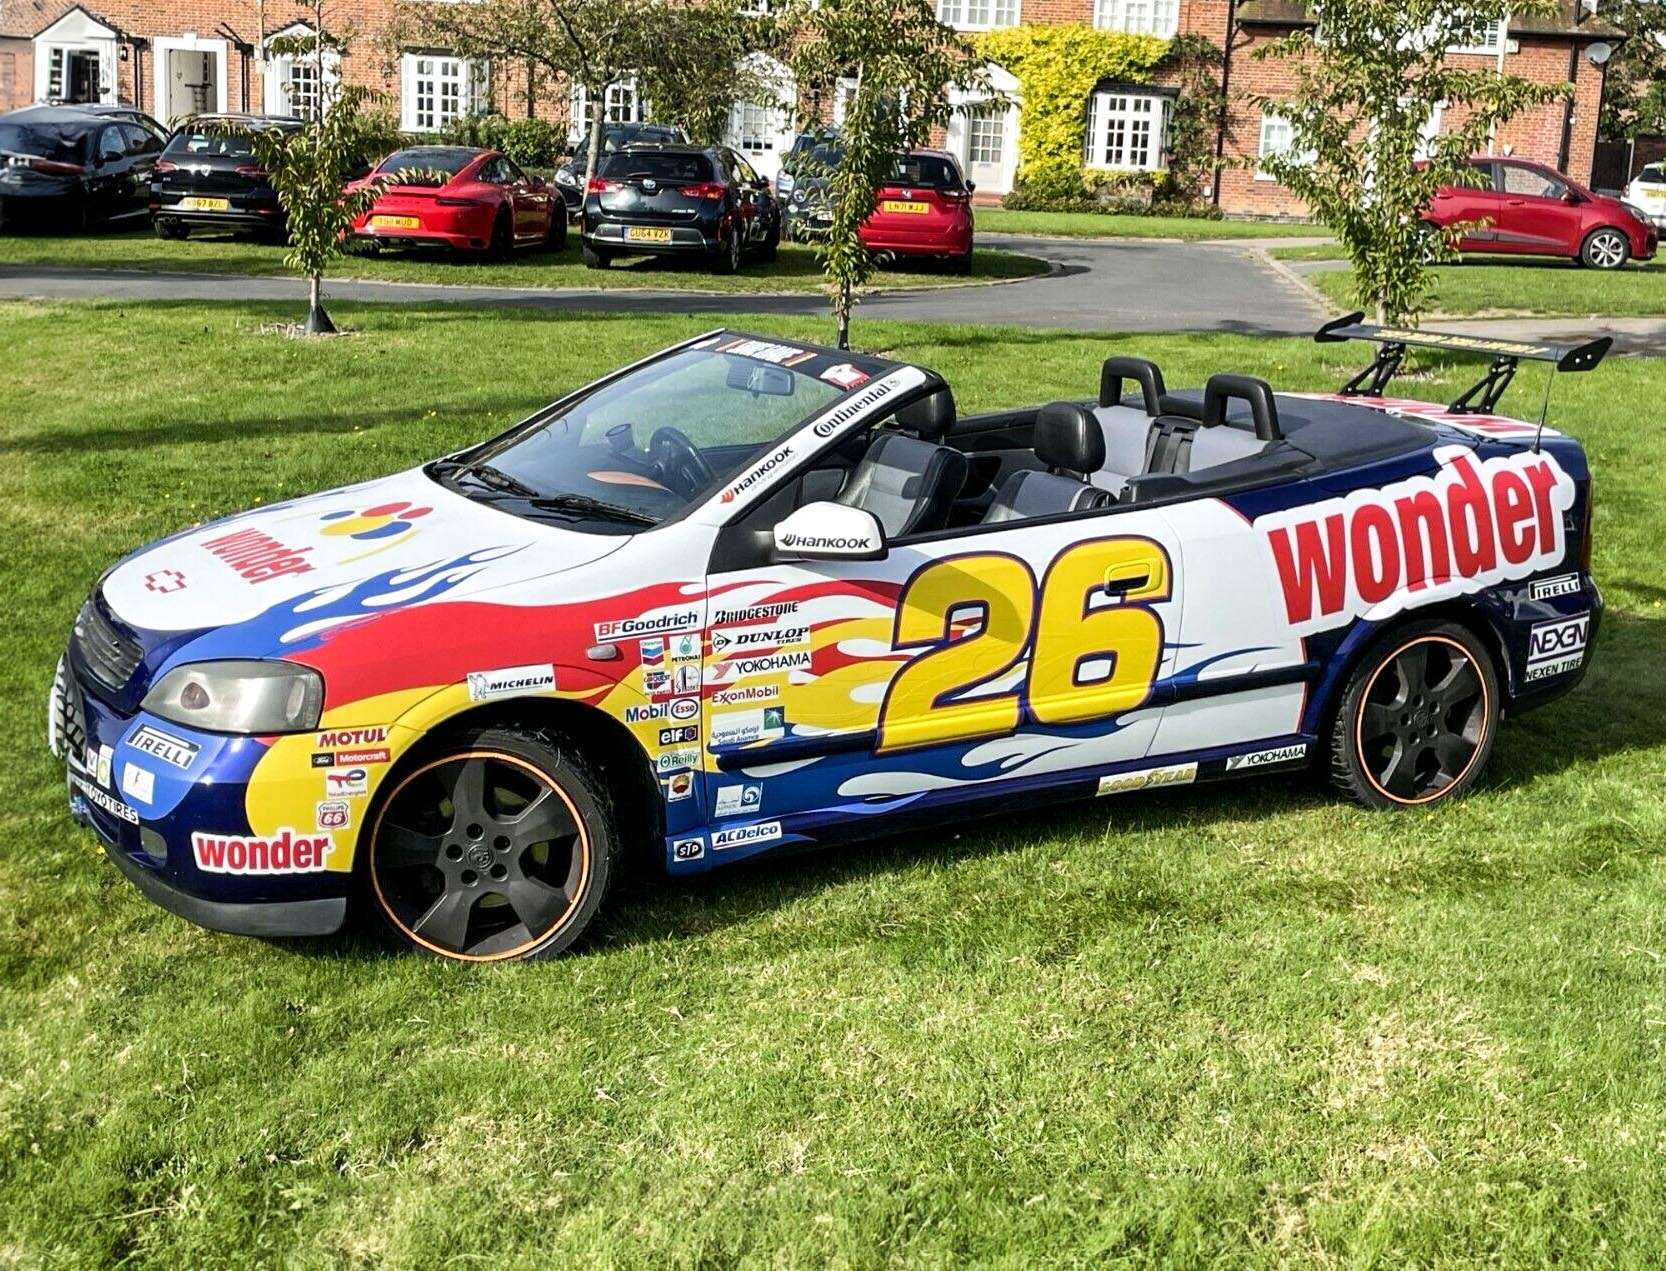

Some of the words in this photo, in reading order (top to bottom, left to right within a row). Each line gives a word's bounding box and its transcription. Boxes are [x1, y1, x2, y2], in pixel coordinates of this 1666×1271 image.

[813, 382, 892, 438] Continental
[1267, 453, 1559, 625] wonder
[200, 528, 317, 585] wonder
[1530, 574, 1579, 600] PIRELLI
[598, 611, 698, 637] BFGoodrich
[714, 602, 799, 625] BRIDGESTONE
[735, 627, 810, 645] DUNLOP
[876, 534, 1173, 754] 26
[1530, 621, 1588, 656] NEXEN
[736, 652, 811, 675] YOKOHAMA
[1526, 662, 1558, 681] NEXEN
[1561, 656, 1583, 672] TIRE
[490, 675, 554, 691] MICHELIN
[712, 685, 779, 705] ExxonMobil
[626, 704, 667, 723] Mobil
[675, 704, 695, 714] Esso
[127, 724, 201, 769] PIRELLI
[319, 728, 386, 747] MOTUL
[661, 729, 684, 744] elf
[339, 752, 387, 763] Motorcraft
[1247, 745, 1305, 764] YOKOHAMA
[107, 796, 137, 823] TIRES
[323, 813, 342, 824] 66
[716, 823, 778, 844] ACDelco
[196, 831, 330, 870] wonder
[679, 842, 700, 857] STP
